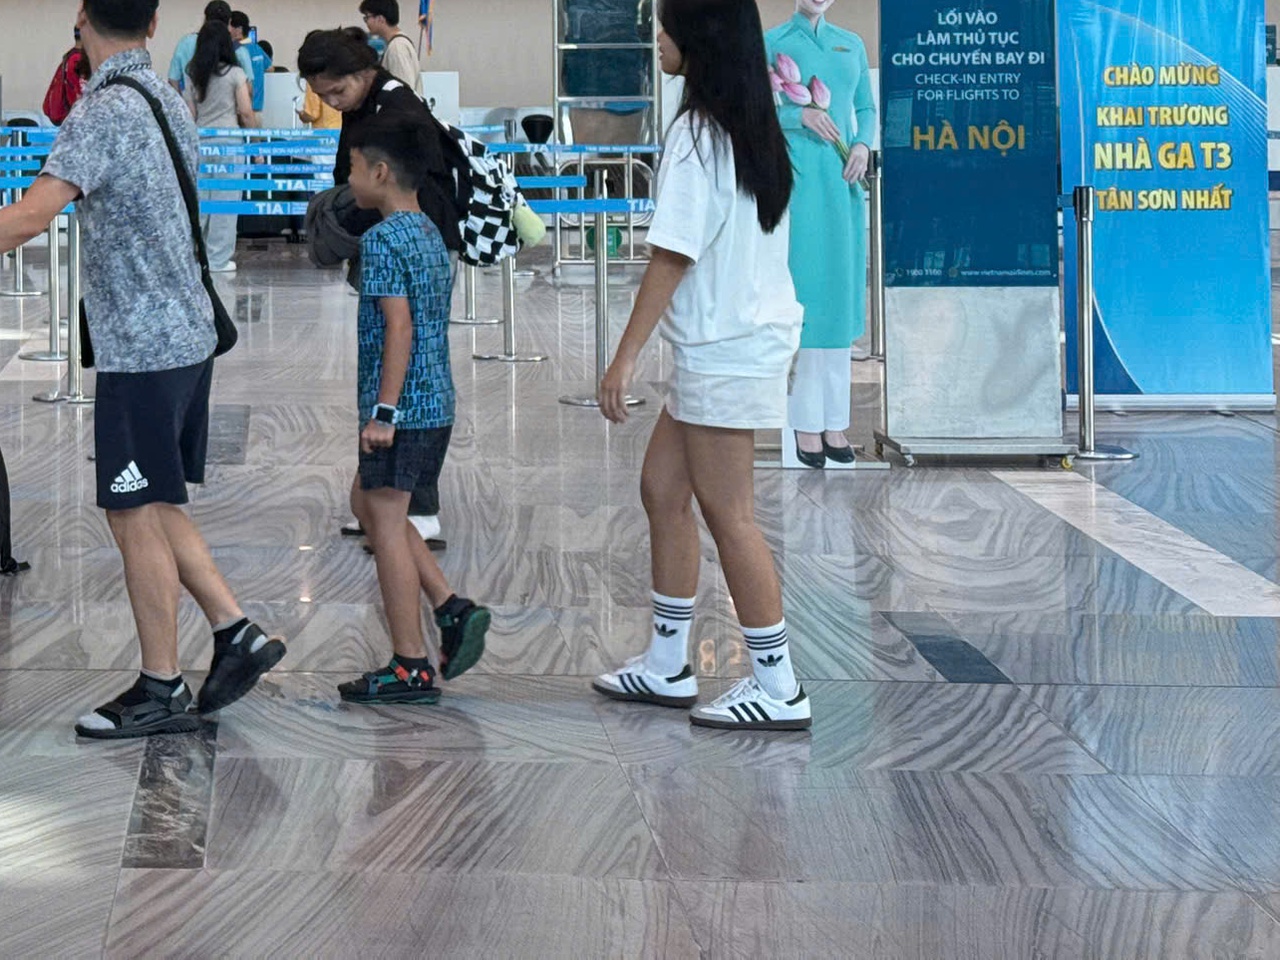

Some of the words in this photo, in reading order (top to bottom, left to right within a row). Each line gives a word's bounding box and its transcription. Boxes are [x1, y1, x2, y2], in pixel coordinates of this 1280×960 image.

[937, 7, 963, 26] LỐI
[964, 8, 998, 26] VÀO
[917, 27, 951, 45] LÀM
[952, 27, 985, 45] THỦ
[988, 31, 1019, 49] TỤC
[892, 51, 926, 66] CHO
[928, 47, 992, 66] CHUYẾN
[995, 51, 1025, 65] BAY
[1028, 51, 1045, 65] ĐI
[915, 73, 977, 85] CHECK-IN
[979, 72, 1021, 85] ENTRY
[1103, 61, 1155, 87] CHÀO
[1159, 61, 1220, 86] MỪNG
[917, 89, 944, 101] FOR
[946, 88, 999, 101] FLIGHTS
[1001, 88, 1020, 101] TO
[1097, 105, 1144, 127] KHAI
[1148, 103, 1229, 127] TRƯƠNG
[913, 119, 959, 151] HÀ
[968, 118, 1026, 158] NỘI
[200, 146, 221, 156] TIA
[1094, 137, 1152, 171] NHÀ
[1157, 142, 1196, 170] GA
[1200, 142, 1233, 170] T3
[206, 164, 228, 173] TIA
[274, 180, 307, 190] TIA
[627, 199, 656, 211] TIA
[1097, 185, 1135, 211] TÂN
[1137, 187, 1179, 211] SƠN
[1181, 182, 1233, 211] NHẤT
[255, 203, 284, 214] TIA
[110, 477, 149, 493] adidas
